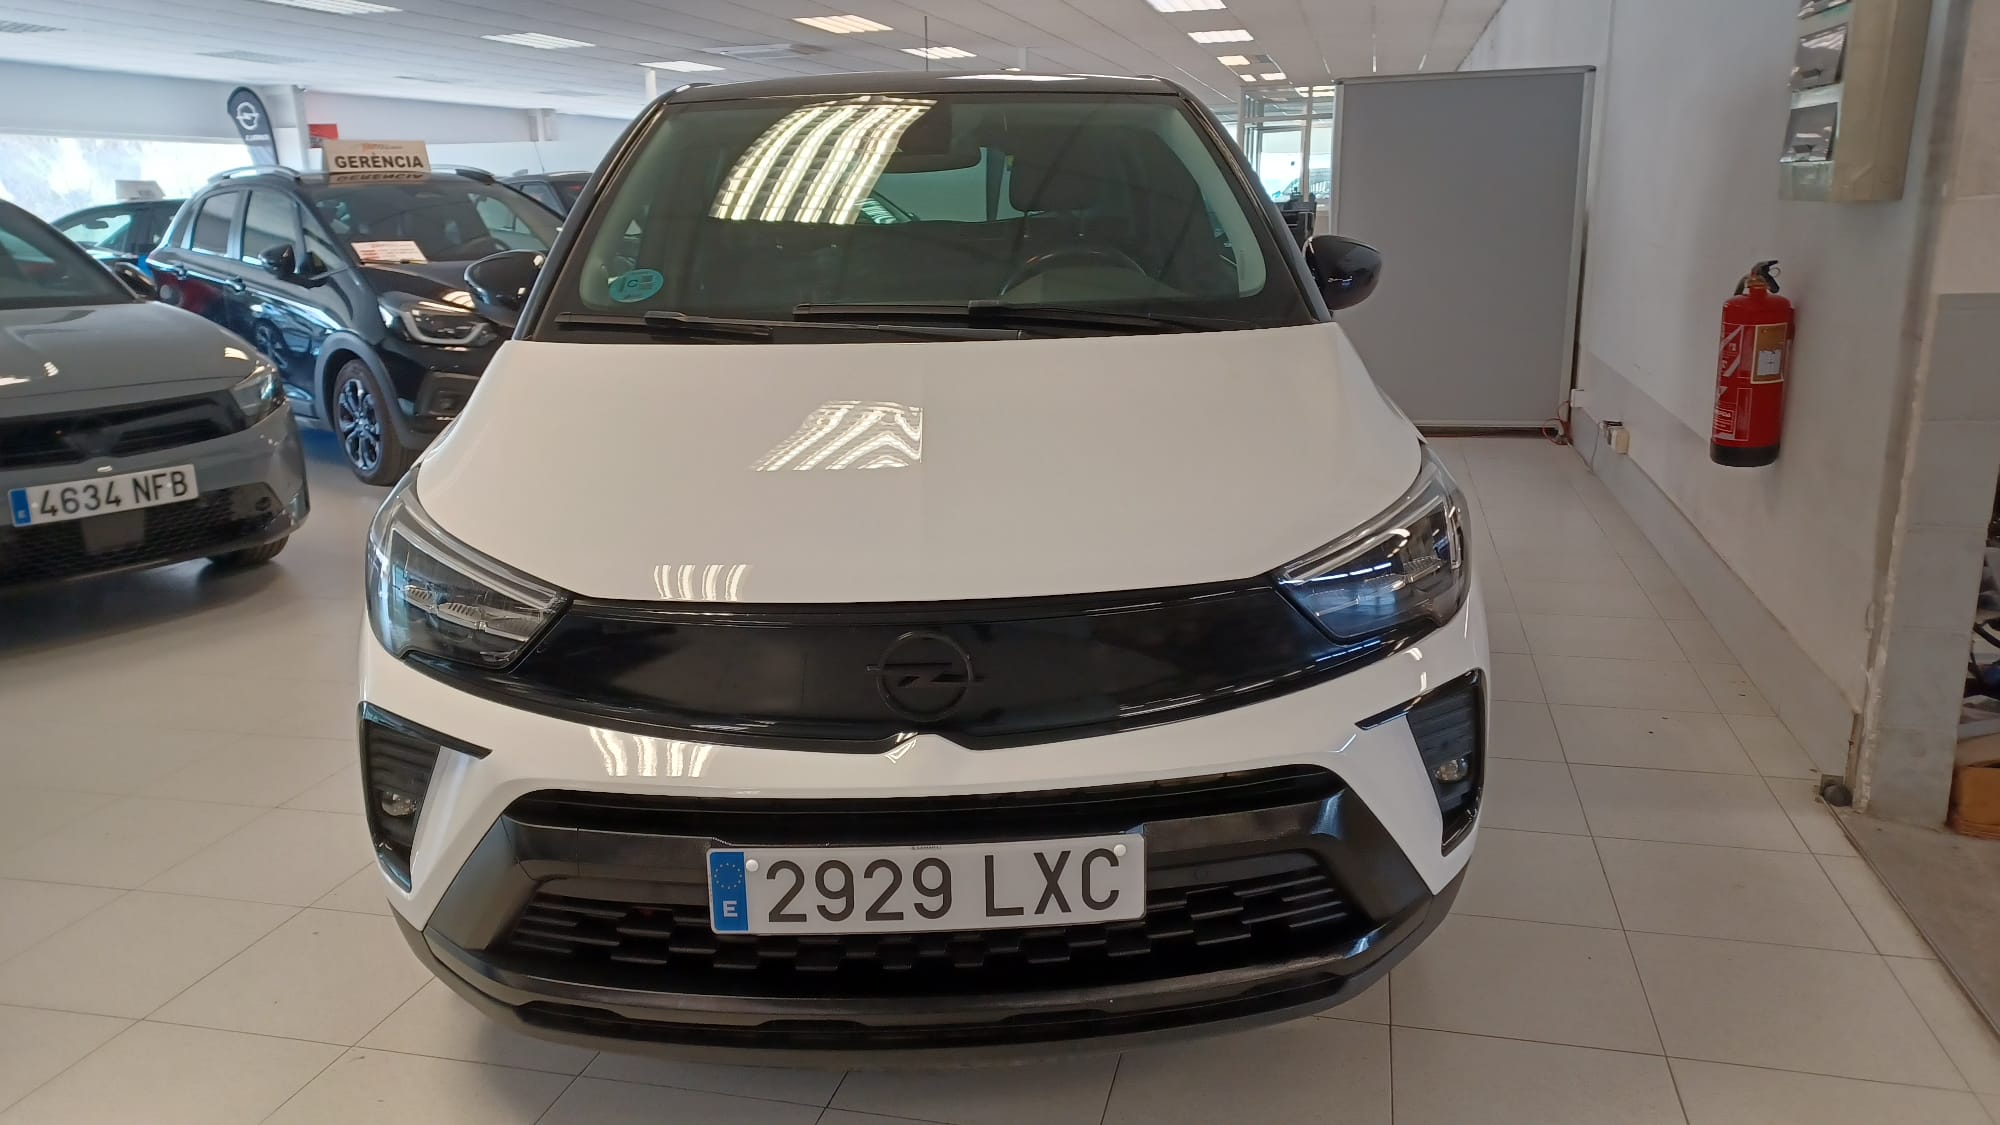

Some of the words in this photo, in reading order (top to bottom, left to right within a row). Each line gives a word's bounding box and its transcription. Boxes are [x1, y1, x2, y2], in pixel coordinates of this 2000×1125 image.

[40, 482, 121, 516] 4634
[132, 471, 188, 503] NFB
[722, 900, 738, 918] E
[766, 857, 952, 923] 2929
[984, 848, 1120, 917] LXC
